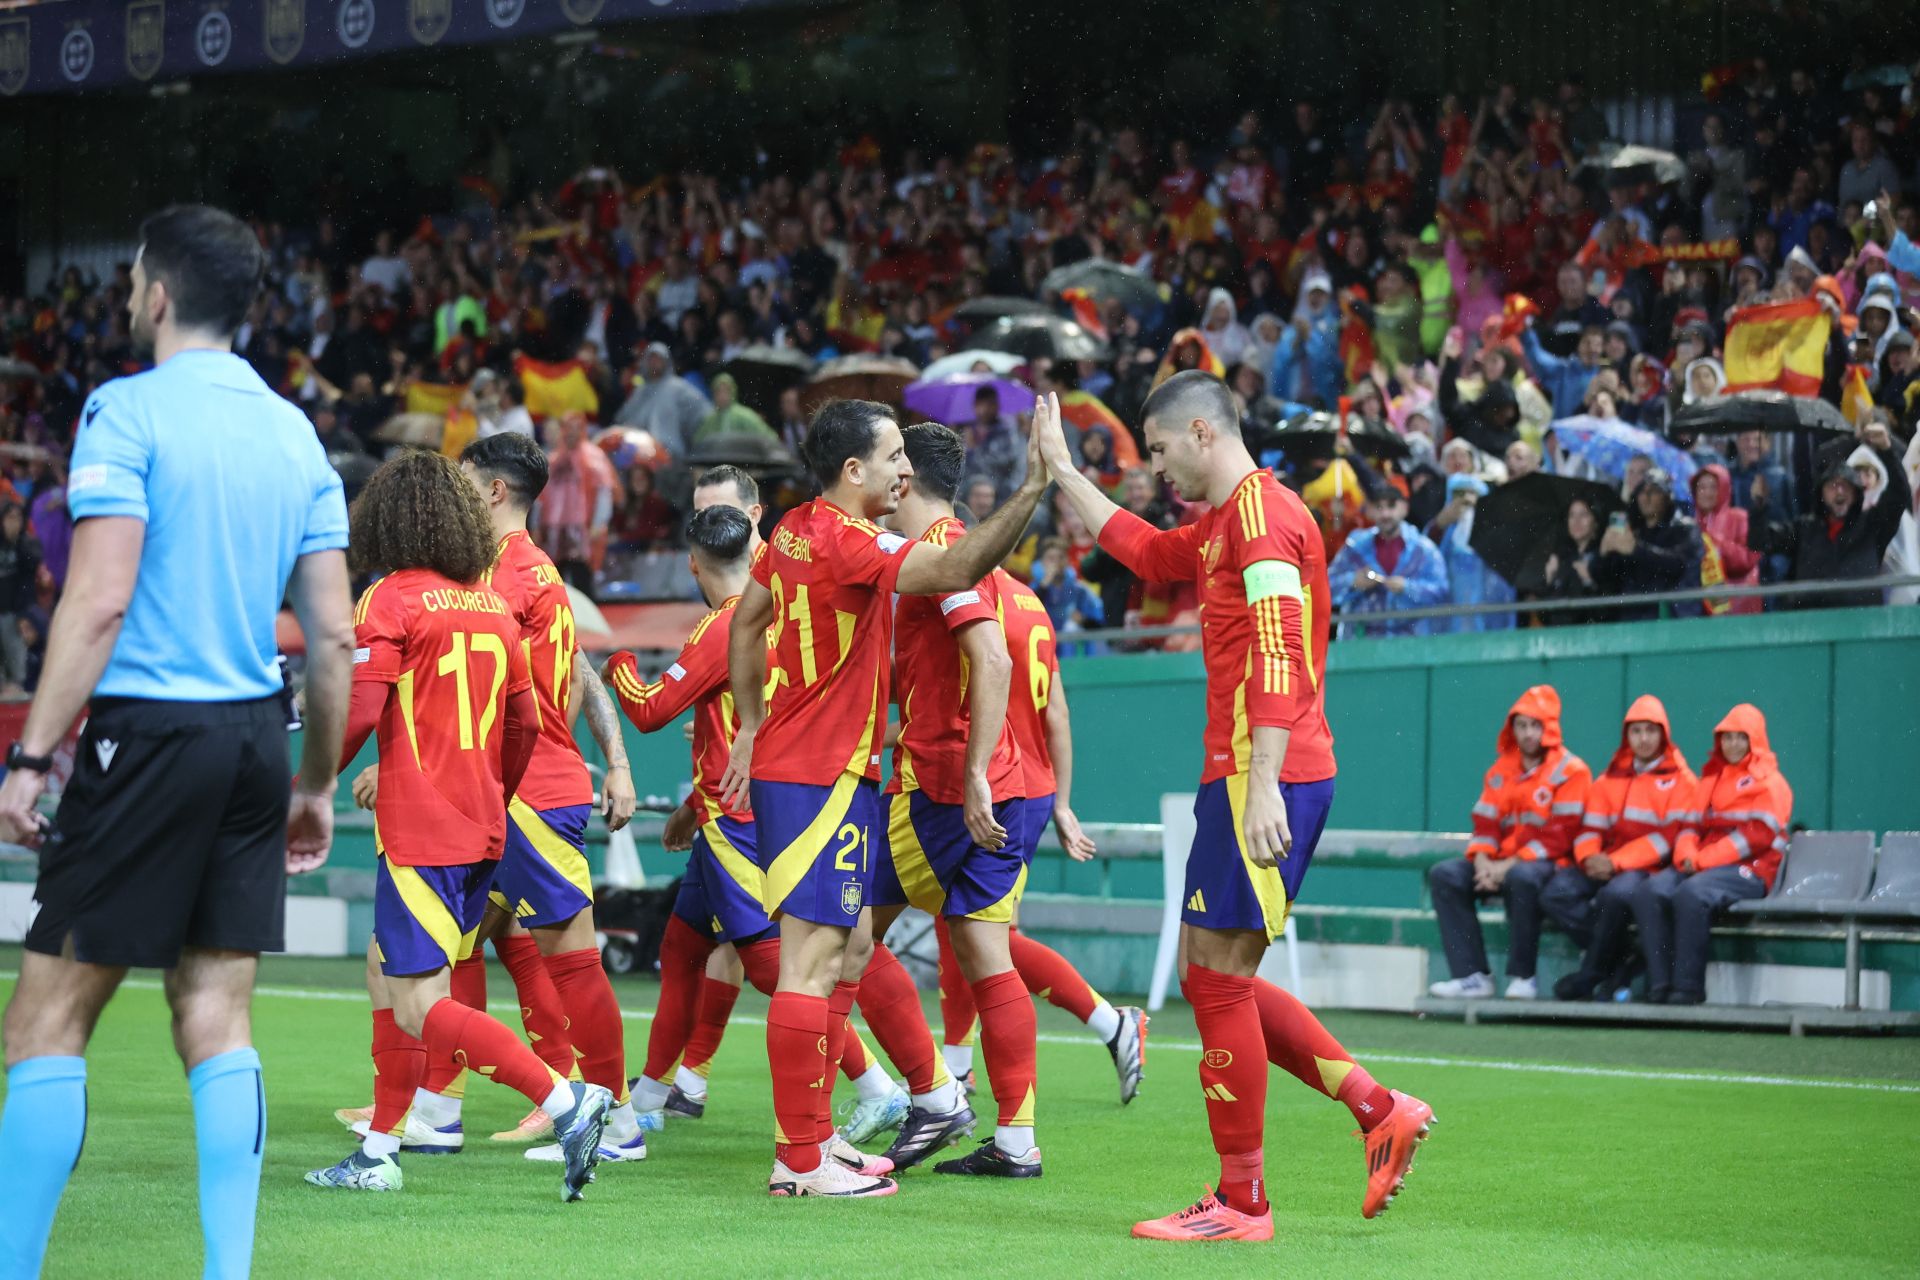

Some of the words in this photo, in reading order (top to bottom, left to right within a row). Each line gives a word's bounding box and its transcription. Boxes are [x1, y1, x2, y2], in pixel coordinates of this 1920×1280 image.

[421, 588, 505, 616] CUCURELLA
[438, 631, 508, 750] 17
[1028, 624, 1051, 714] 6
[834, 822, 869, 873] 21
